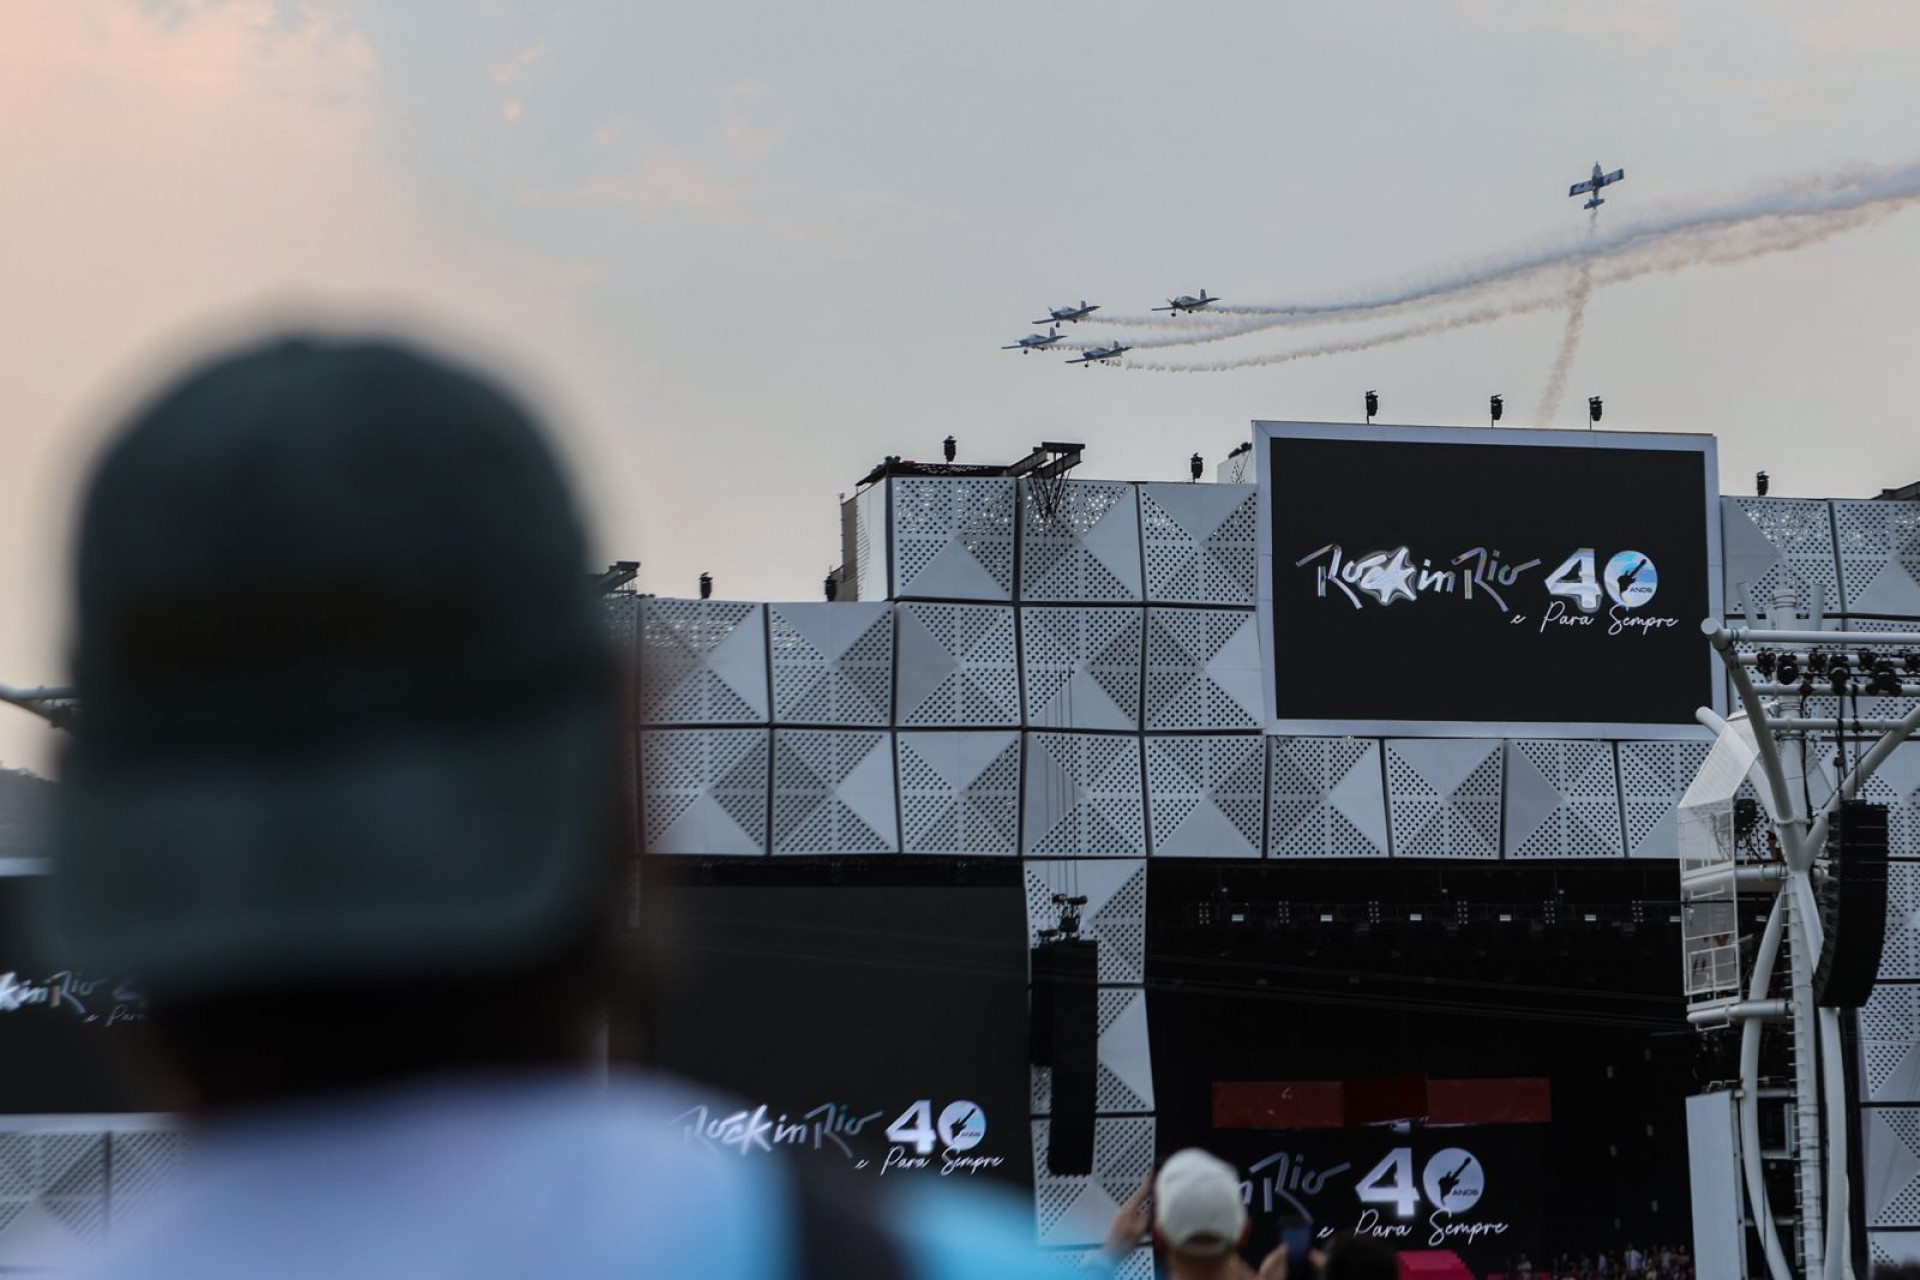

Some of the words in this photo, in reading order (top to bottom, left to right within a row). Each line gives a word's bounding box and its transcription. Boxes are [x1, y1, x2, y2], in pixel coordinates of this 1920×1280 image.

[1417, 558, 1456, 593] in
[1451, 547, 1542, 612] Rio
[1544, 547, 1659, 612] 40
[1509, 612, 1526, 625] e
[1539, 600, 1595, 634] Para
[1607, 602, 1680, 636] Sempre
[773, 1114, 806, 1144] in
[804, 1102, 883, 1158] Rio
[885, 1099, 987, 1155] 40
[854, 1159, 870, 1170] e
[880, 1146, 931, 1177] Para
[940, 1145, 1004, 1177] Sempre
[1249, 1151, 1351, 1224] Rio
[1354, 1147, 1485, 1217] 40
[1316, 1225, 1335, 1239] e
[1353, 1208, 1413, 1238] Para
[1428, 1207, 1510, 1247] Sempre
